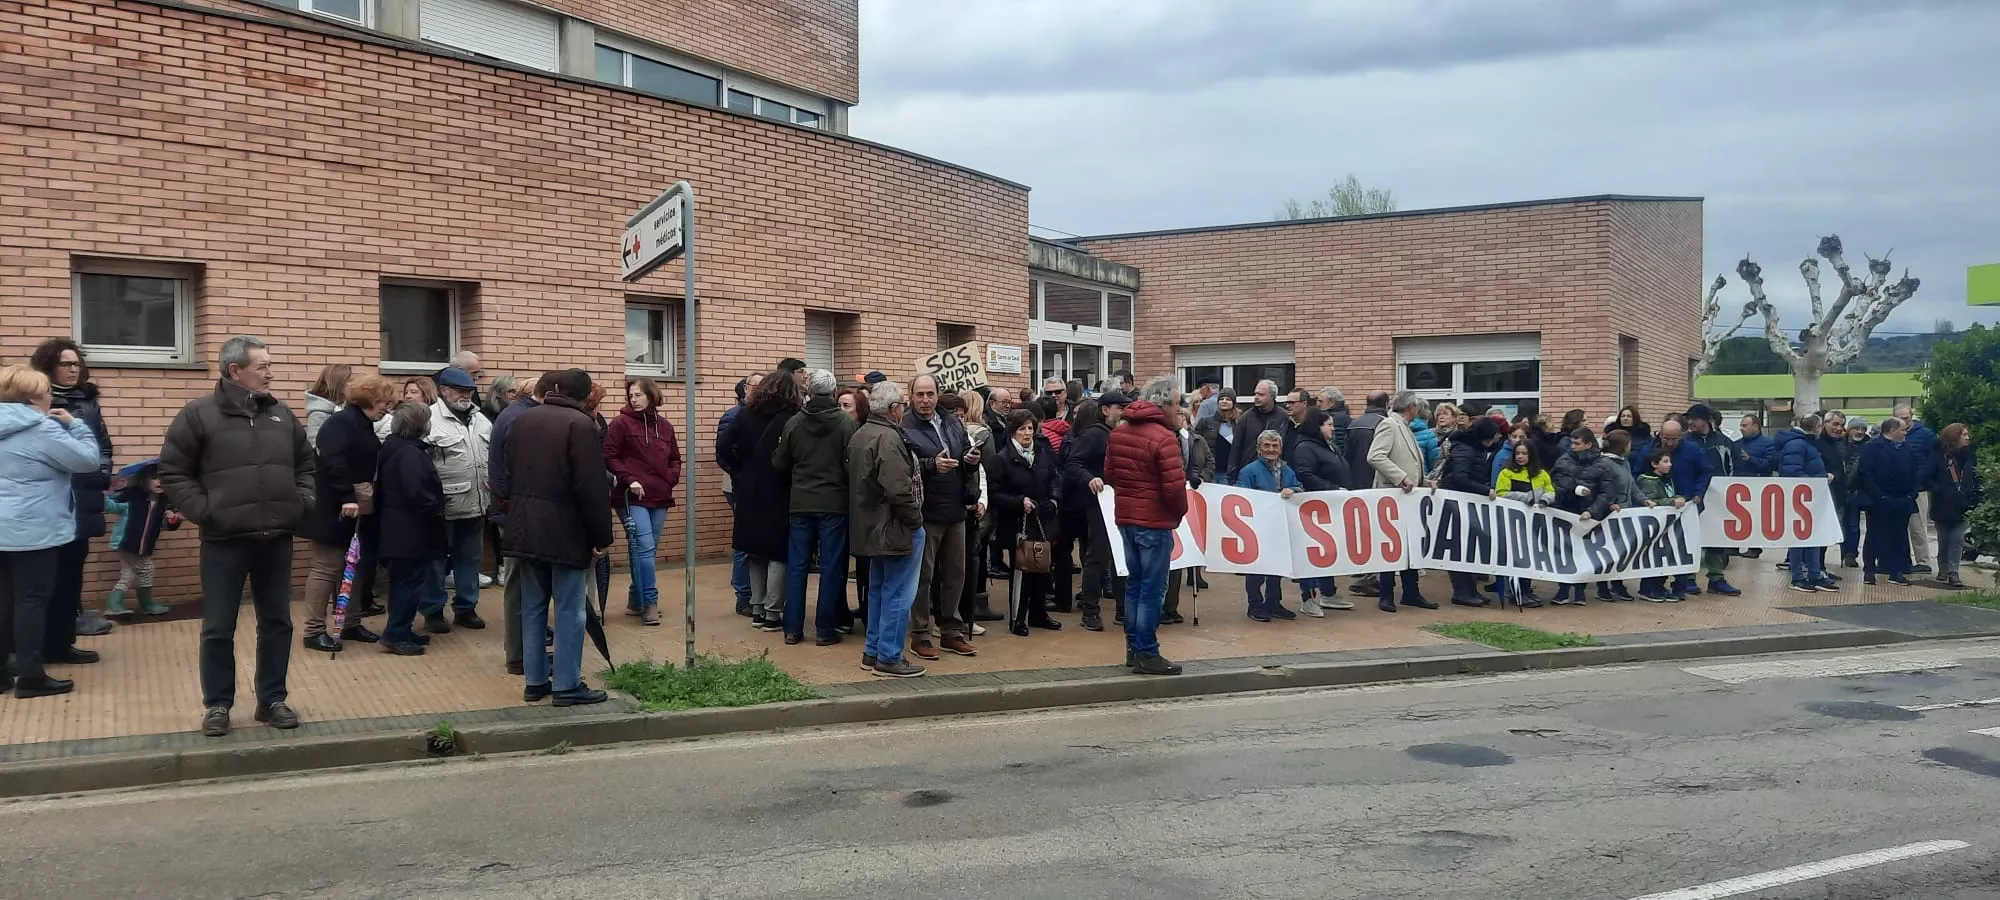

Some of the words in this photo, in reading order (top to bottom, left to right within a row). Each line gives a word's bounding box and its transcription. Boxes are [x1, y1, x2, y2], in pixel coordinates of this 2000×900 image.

[653, 207, 676, 230] servicios
[655, 227, 677, 248] médicos
[926, 346, 971, 374] SOS
[936, 362, 979, 385] ANIDAD
[1723, 483, 1813, 541] SOS
[1298, 495, 1402, 568] SOS
[1421, 495, 1577, 575] SANIDAD
[1582, 512, 1694, 575] RURAL
